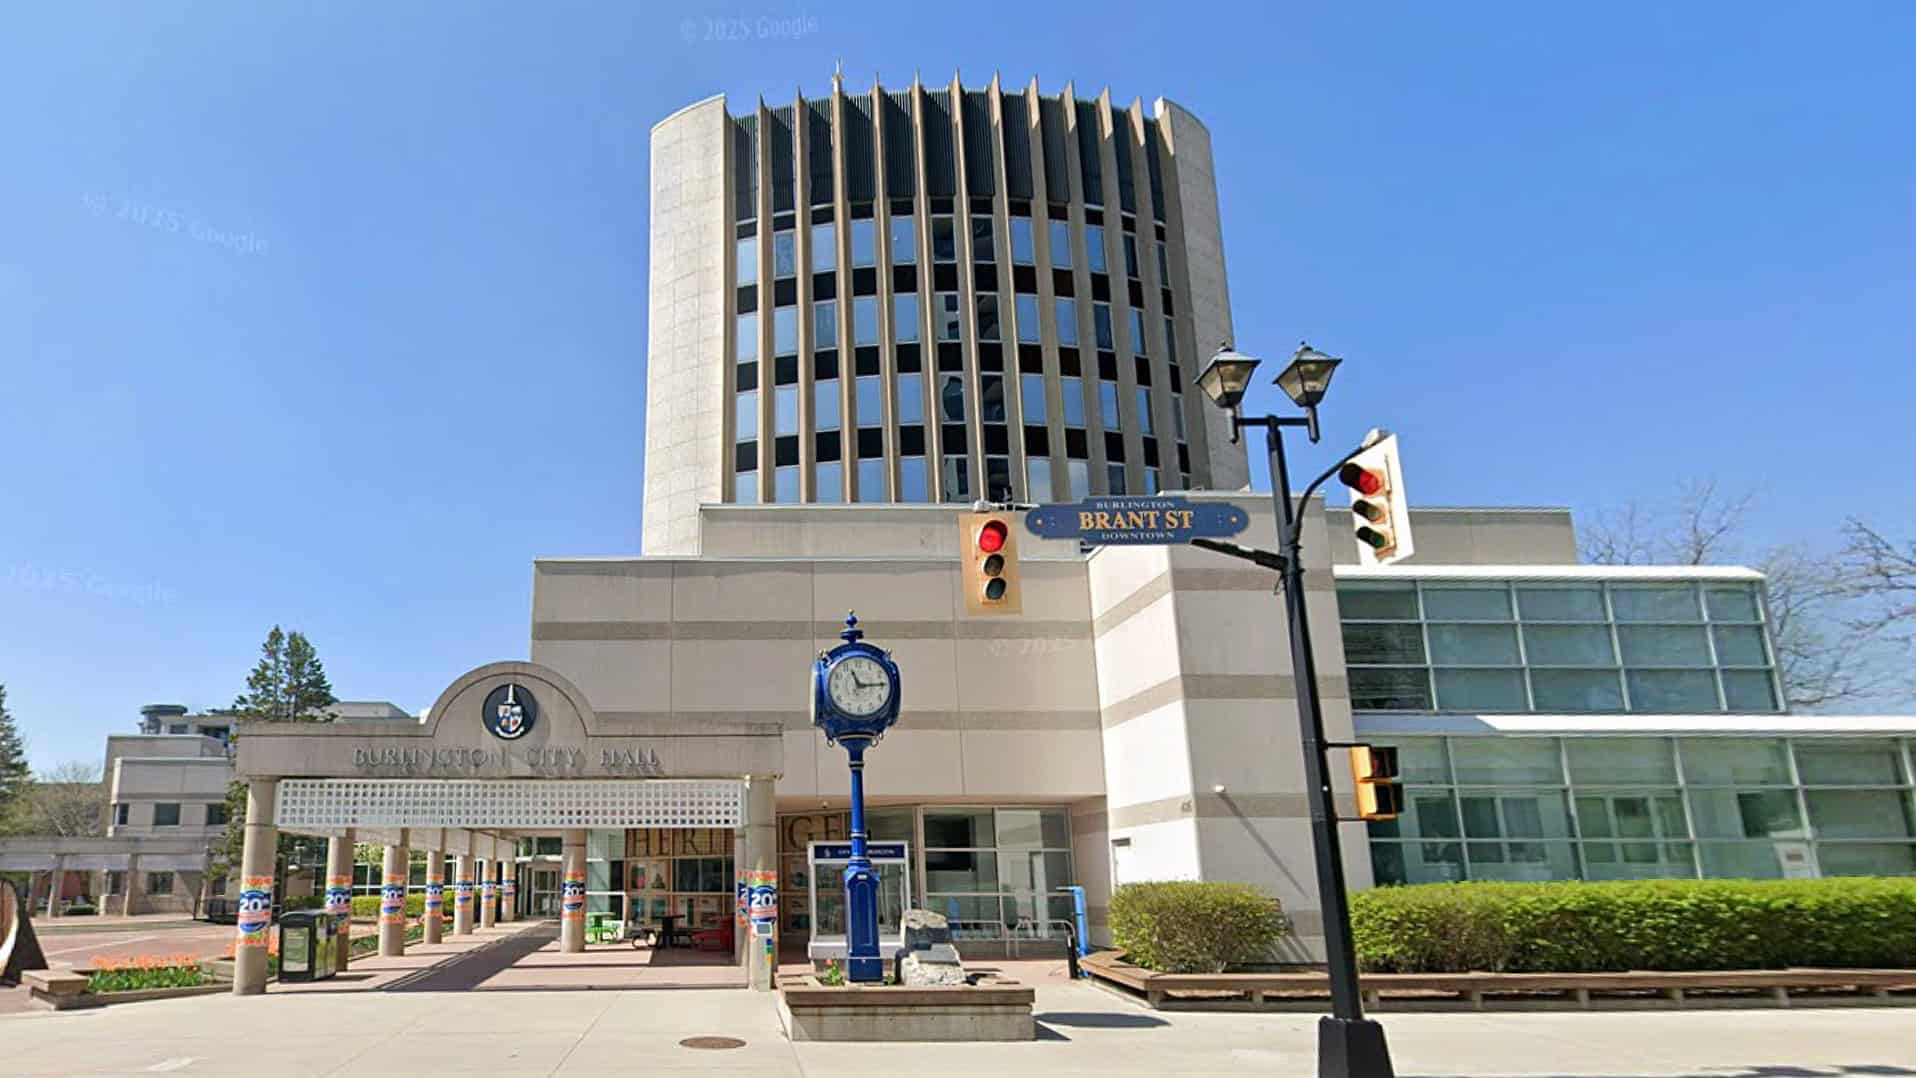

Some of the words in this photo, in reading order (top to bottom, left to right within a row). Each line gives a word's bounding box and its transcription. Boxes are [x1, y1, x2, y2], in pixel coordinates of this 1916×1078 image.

[1096, 501, 1176, 510] BURLINGTON
[1078, 510, 1160, 530] BRANT
[1165, 510, 1194, 530] ST
[1101, 531, 1176, 540] DOWNTOWN
[353, 747, 512, 768] BURLINGTON
[527, 748, 580, 768] CITY
[600, 748, 660, 768] HALL
